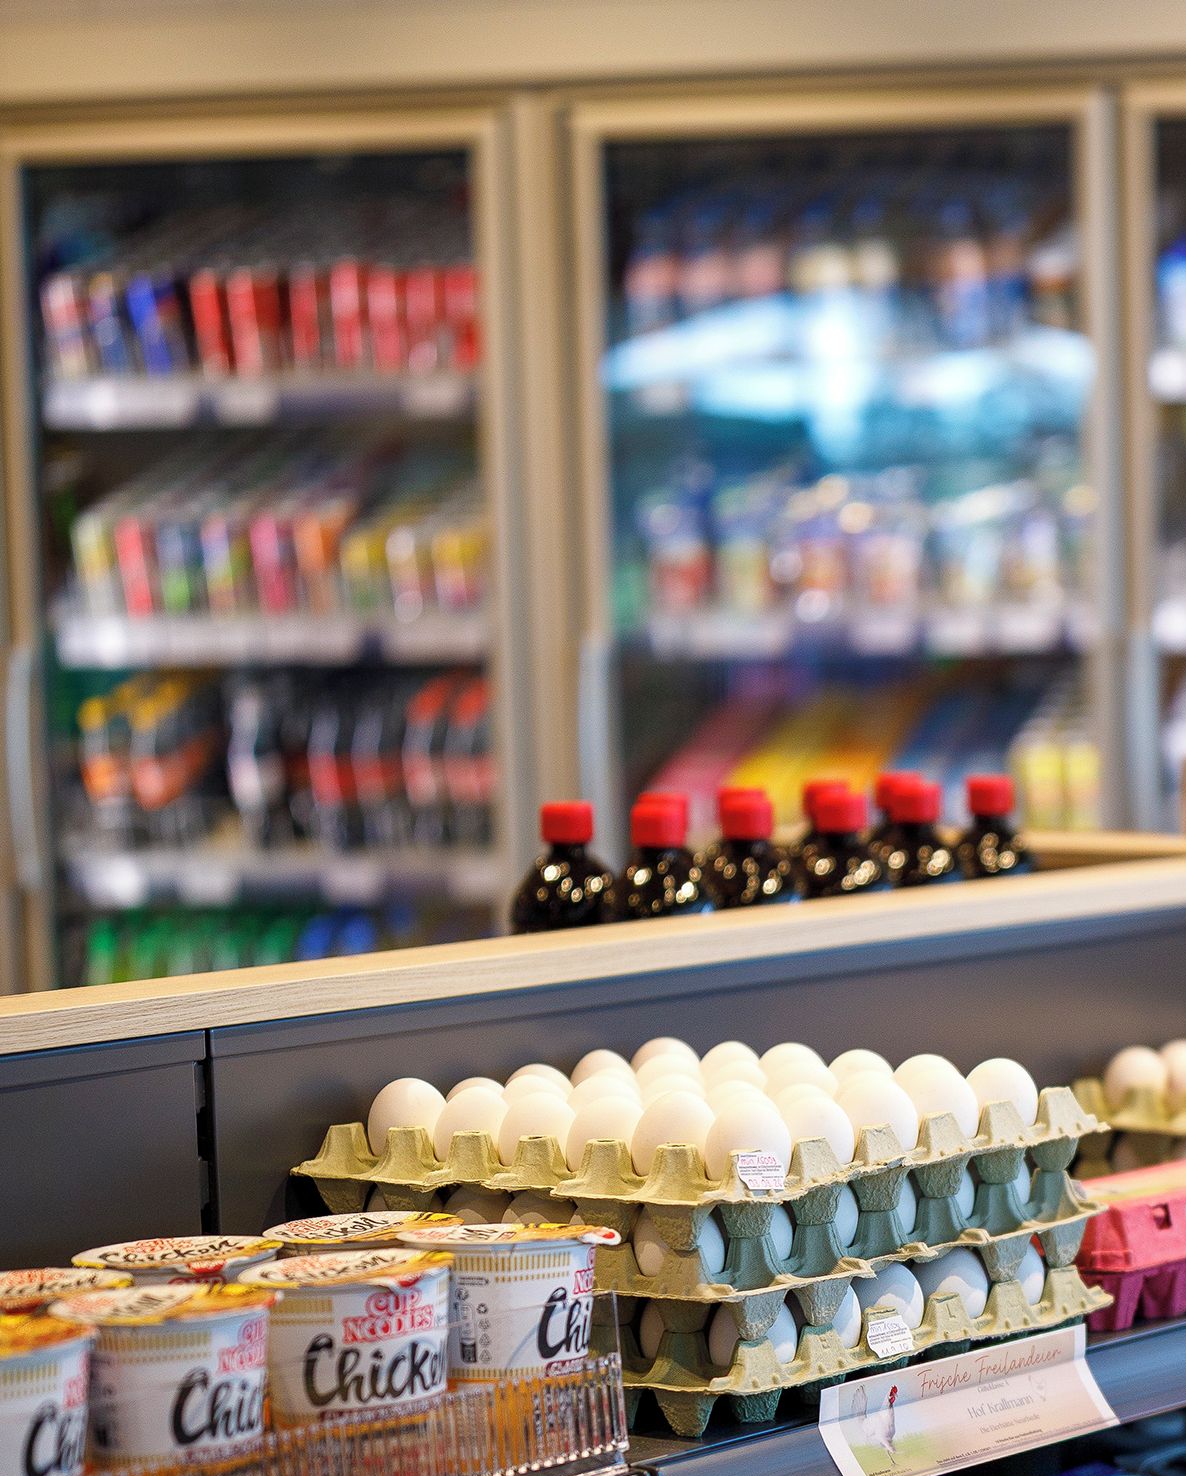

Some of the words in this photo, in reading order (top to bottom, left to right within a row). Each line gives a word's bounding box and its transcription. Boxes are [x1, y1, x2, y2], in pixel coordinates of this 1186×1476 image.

[365, 1288, 423, 1318] CUP
[917, 1363, 971, 1398] Frische
[975, 1347, 1063, 1384] Freilandeier
[967, 1402, 987, 1420] Hof
[988, 1394, 1034, 1417] Krallmann
